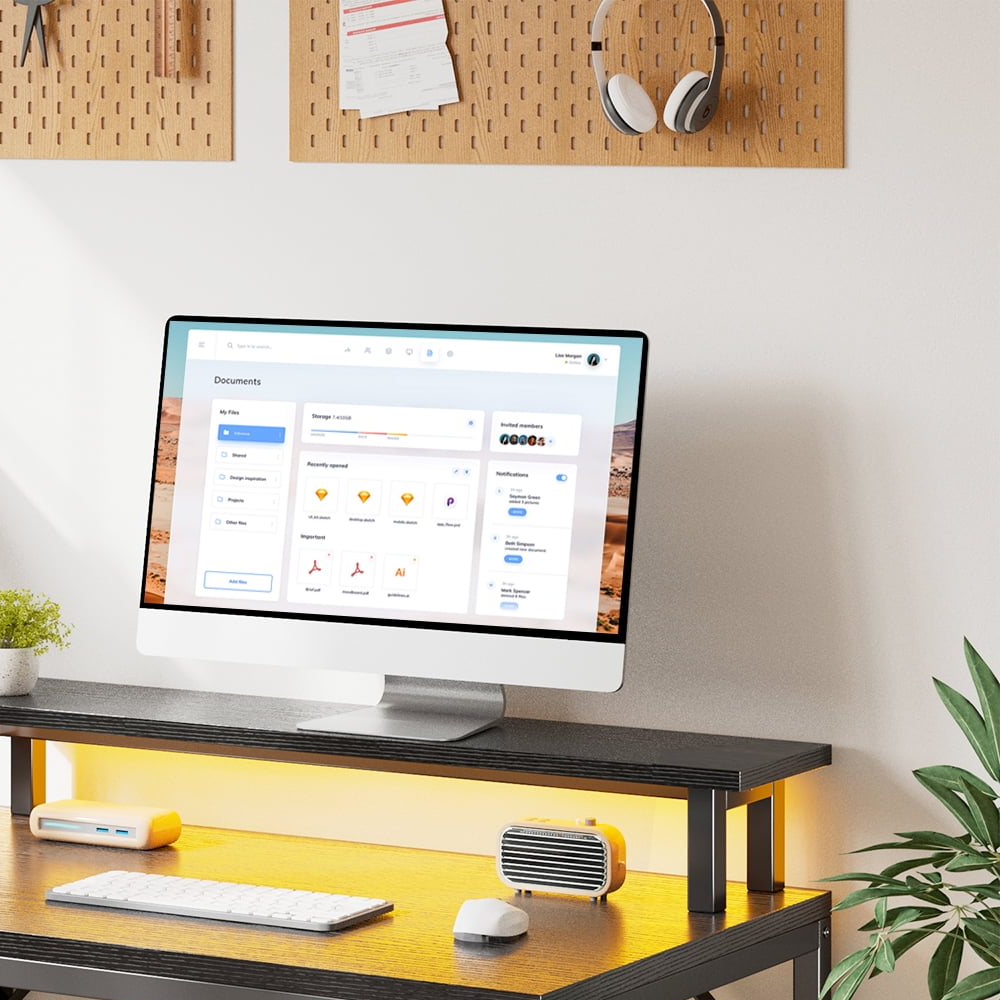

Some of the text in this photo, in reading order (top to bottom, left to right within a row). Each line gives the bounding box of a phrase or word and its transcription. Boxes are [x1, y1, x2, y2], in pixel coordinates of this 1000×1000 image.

[214, 375, 262, 386] Documents
[311, 413, 332, 421] Storage
[500, 421, 519, 429] Invited
[307, 461, 328, 469] Recently
[300, 533, 326, 541] Important
[395, 567, 406, 577] Ai
